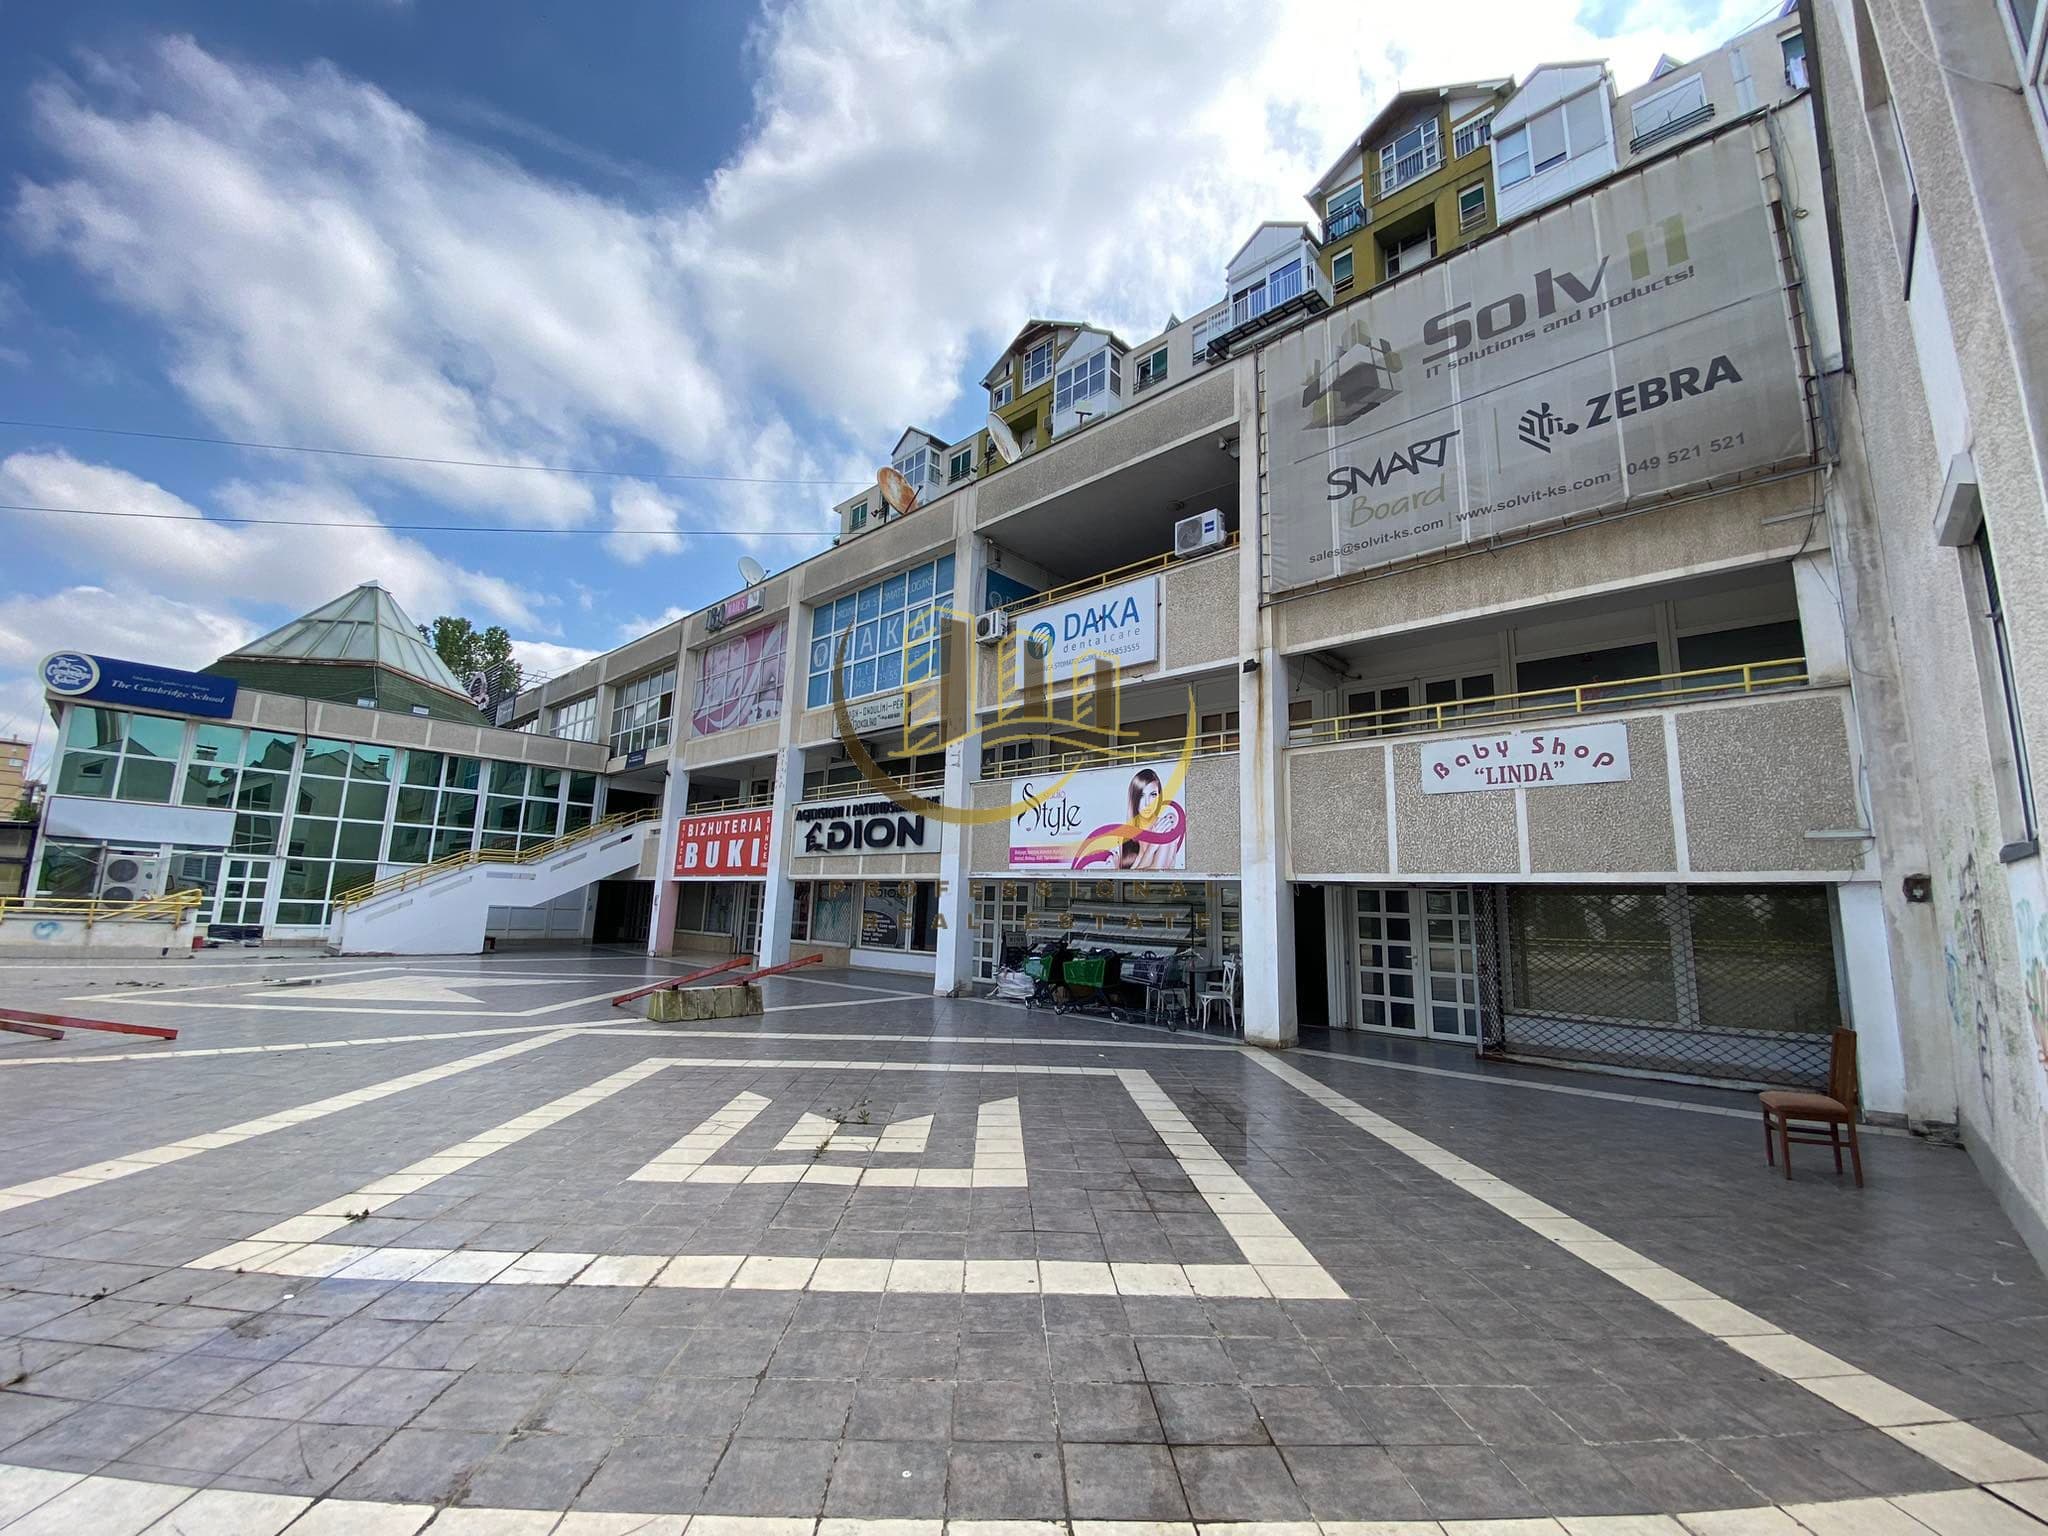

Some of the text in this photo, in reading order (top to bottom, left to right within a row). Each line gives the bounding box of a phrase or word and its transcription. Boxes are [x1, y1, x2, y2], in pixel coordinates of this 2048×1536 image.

[1425, 264, 1696, 379] IT solutions and products!
[1585, 354, 1744, 430] ZEBRA
[1326, 428, 1462, 501] SMART
[1309, 431, 1746, 564] sales@solvit-ks.com www.solvit-ks.com 049 521 521
[1350, 472, 1446, 529] Board
[1063, 627, 1141, 653] dentalcare
[1064, 596, 1140, 642] DAKA
[111, 679, 132, 690] The
[133, 683, 189, 699] Cambridge
[190, 691, 225, 704] School
[1432, 736, 1615, 780] Baby Shop
[687, 817, 762, 838] BIZHUTERIA
[1017, 782, 1082, 837] Style
[684, 837, 761, 869] BUKI
